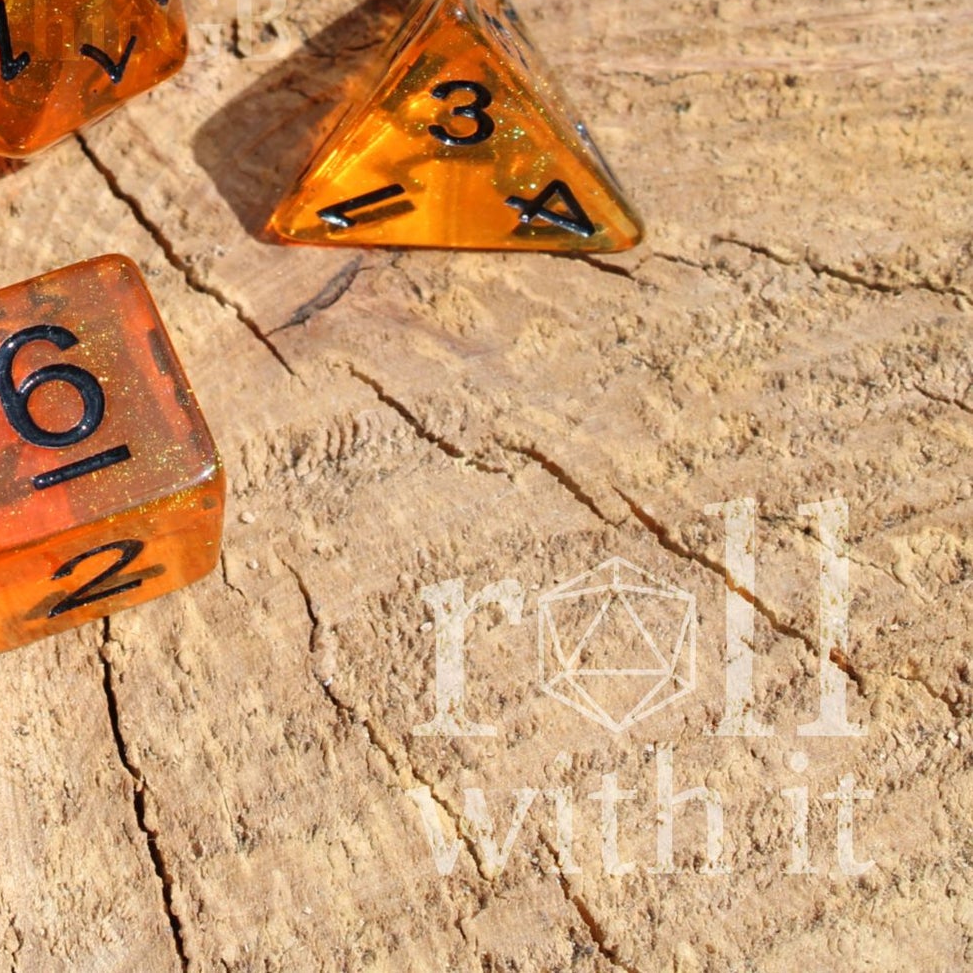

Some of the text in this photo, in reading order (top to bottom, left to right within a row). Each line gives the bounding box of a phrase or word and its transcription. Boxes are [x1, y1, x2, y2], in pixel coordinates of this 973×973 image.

[427, 80, 495, 147] 3
[316, 183, 406, 228] 1
[504, 179, 596, 237] 4
[47, 538, 144, 619] 2
